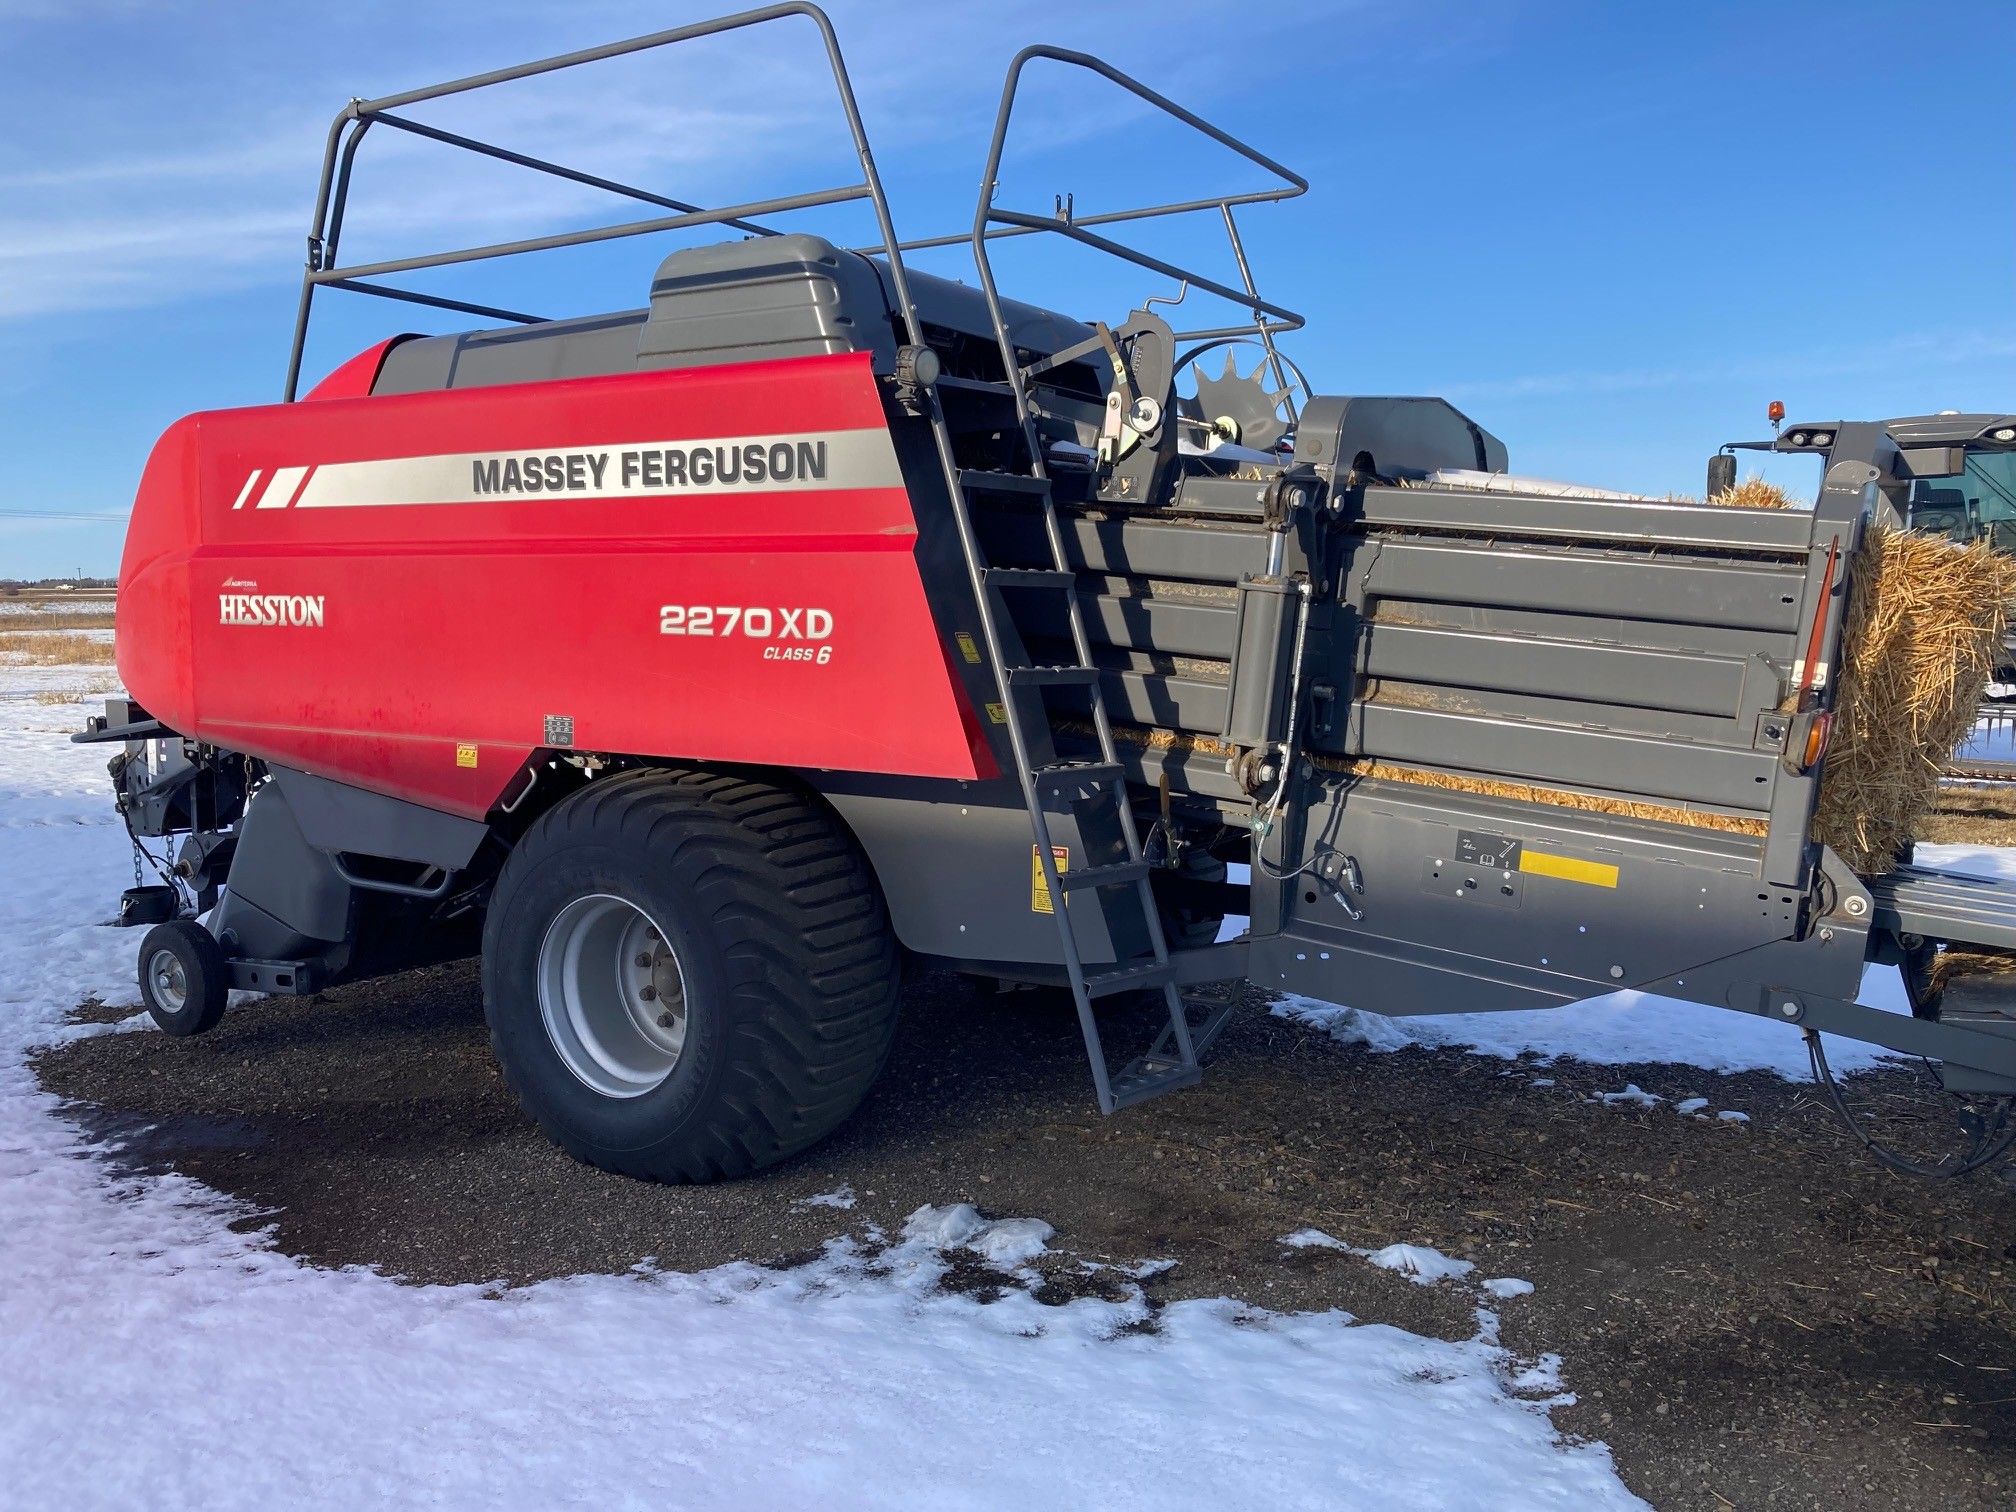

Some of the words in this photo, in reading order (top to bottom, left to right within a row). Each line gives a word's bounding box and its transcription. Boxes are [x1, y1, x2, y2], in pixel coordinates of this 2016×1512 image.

[472, 453, 608, 494] MASSEY
[621, 441, 827, 487] FERGUSON
[219, 594, 325, 627] HESSTON
[763, 646, 814, 661] CLASS
[816, 645, 833, 665] 6
